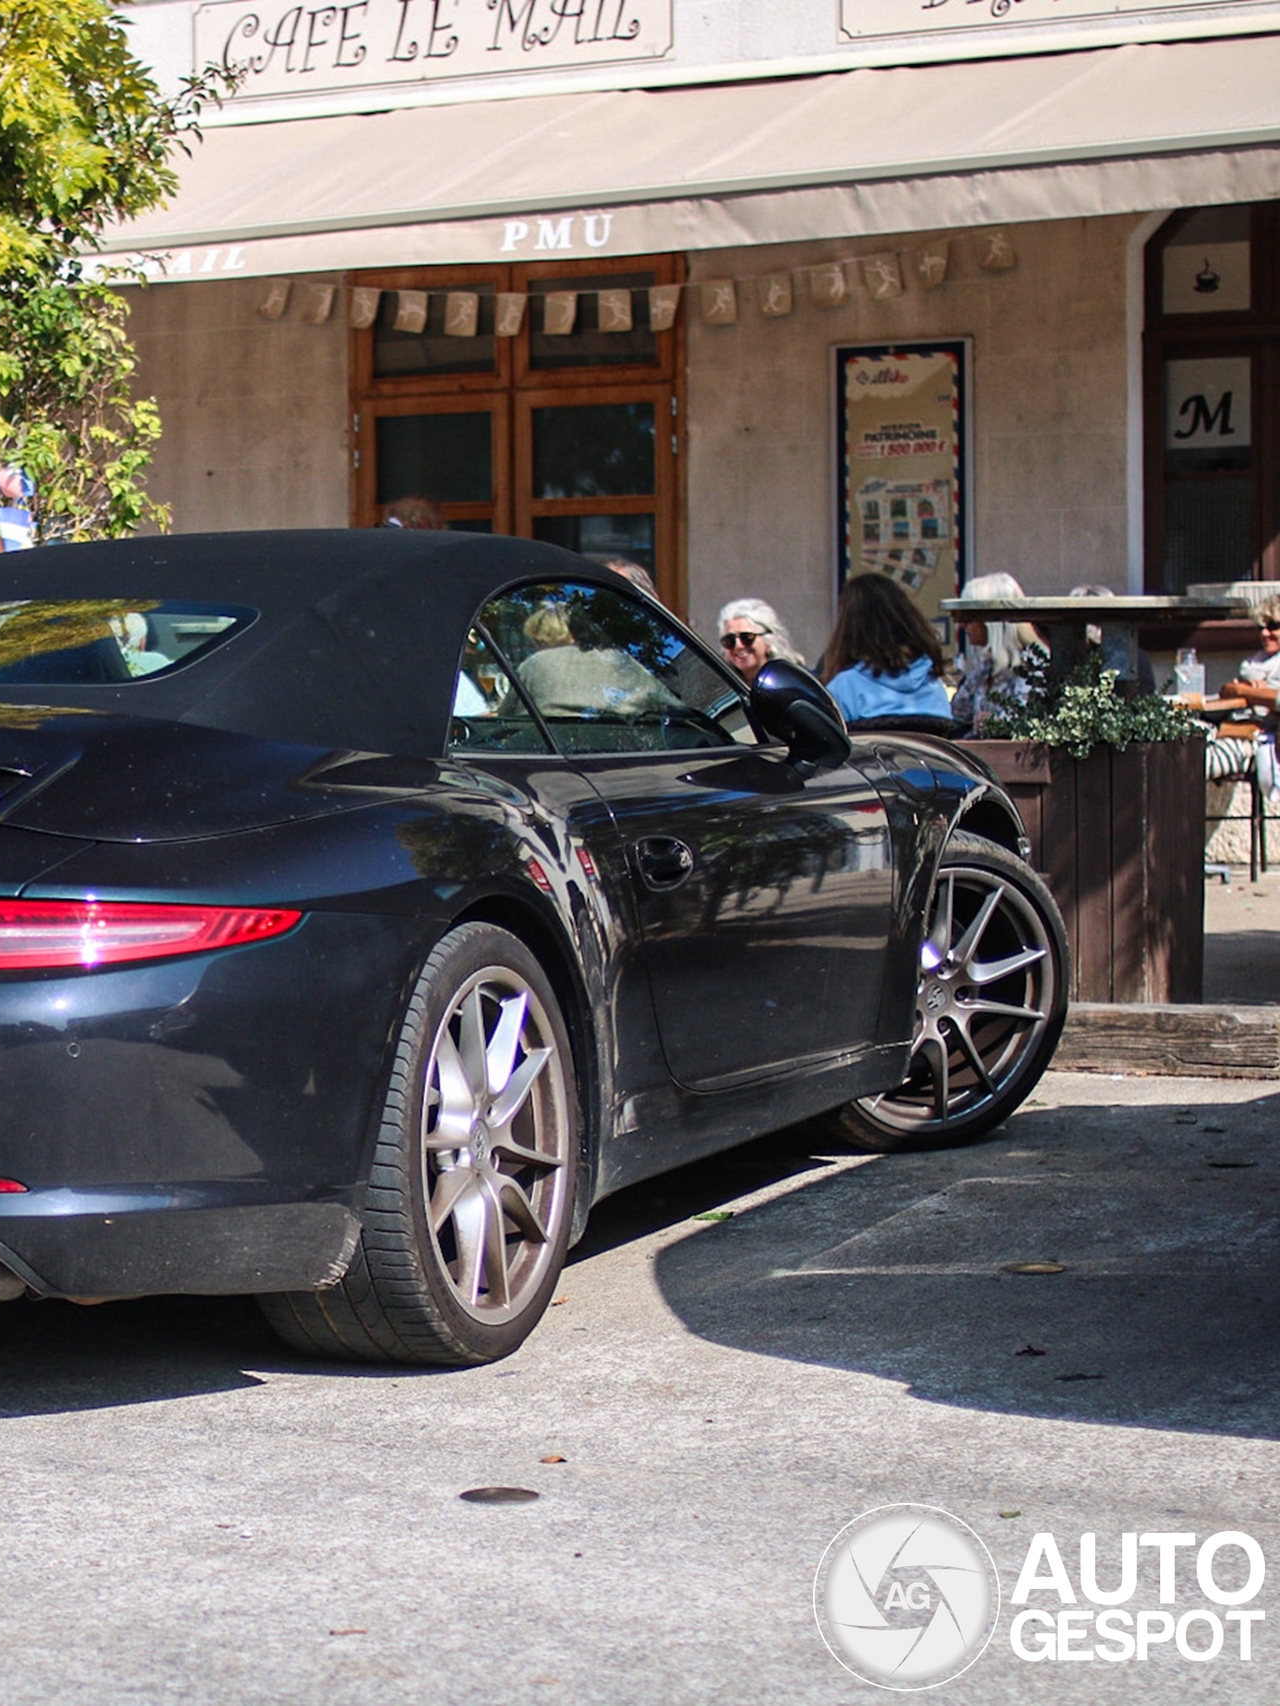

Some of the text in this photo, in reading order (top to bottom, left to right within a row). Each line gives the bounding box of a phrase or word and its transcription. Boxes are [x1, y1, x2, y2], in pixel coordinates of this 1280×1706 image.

[222, 0, 641, 75] CAFE LE MAIL
[499, 214, 614, 252] PMU
[864, 431, 937, 442] PATRIMOINE
[1174, 390, 1235, 440] M
